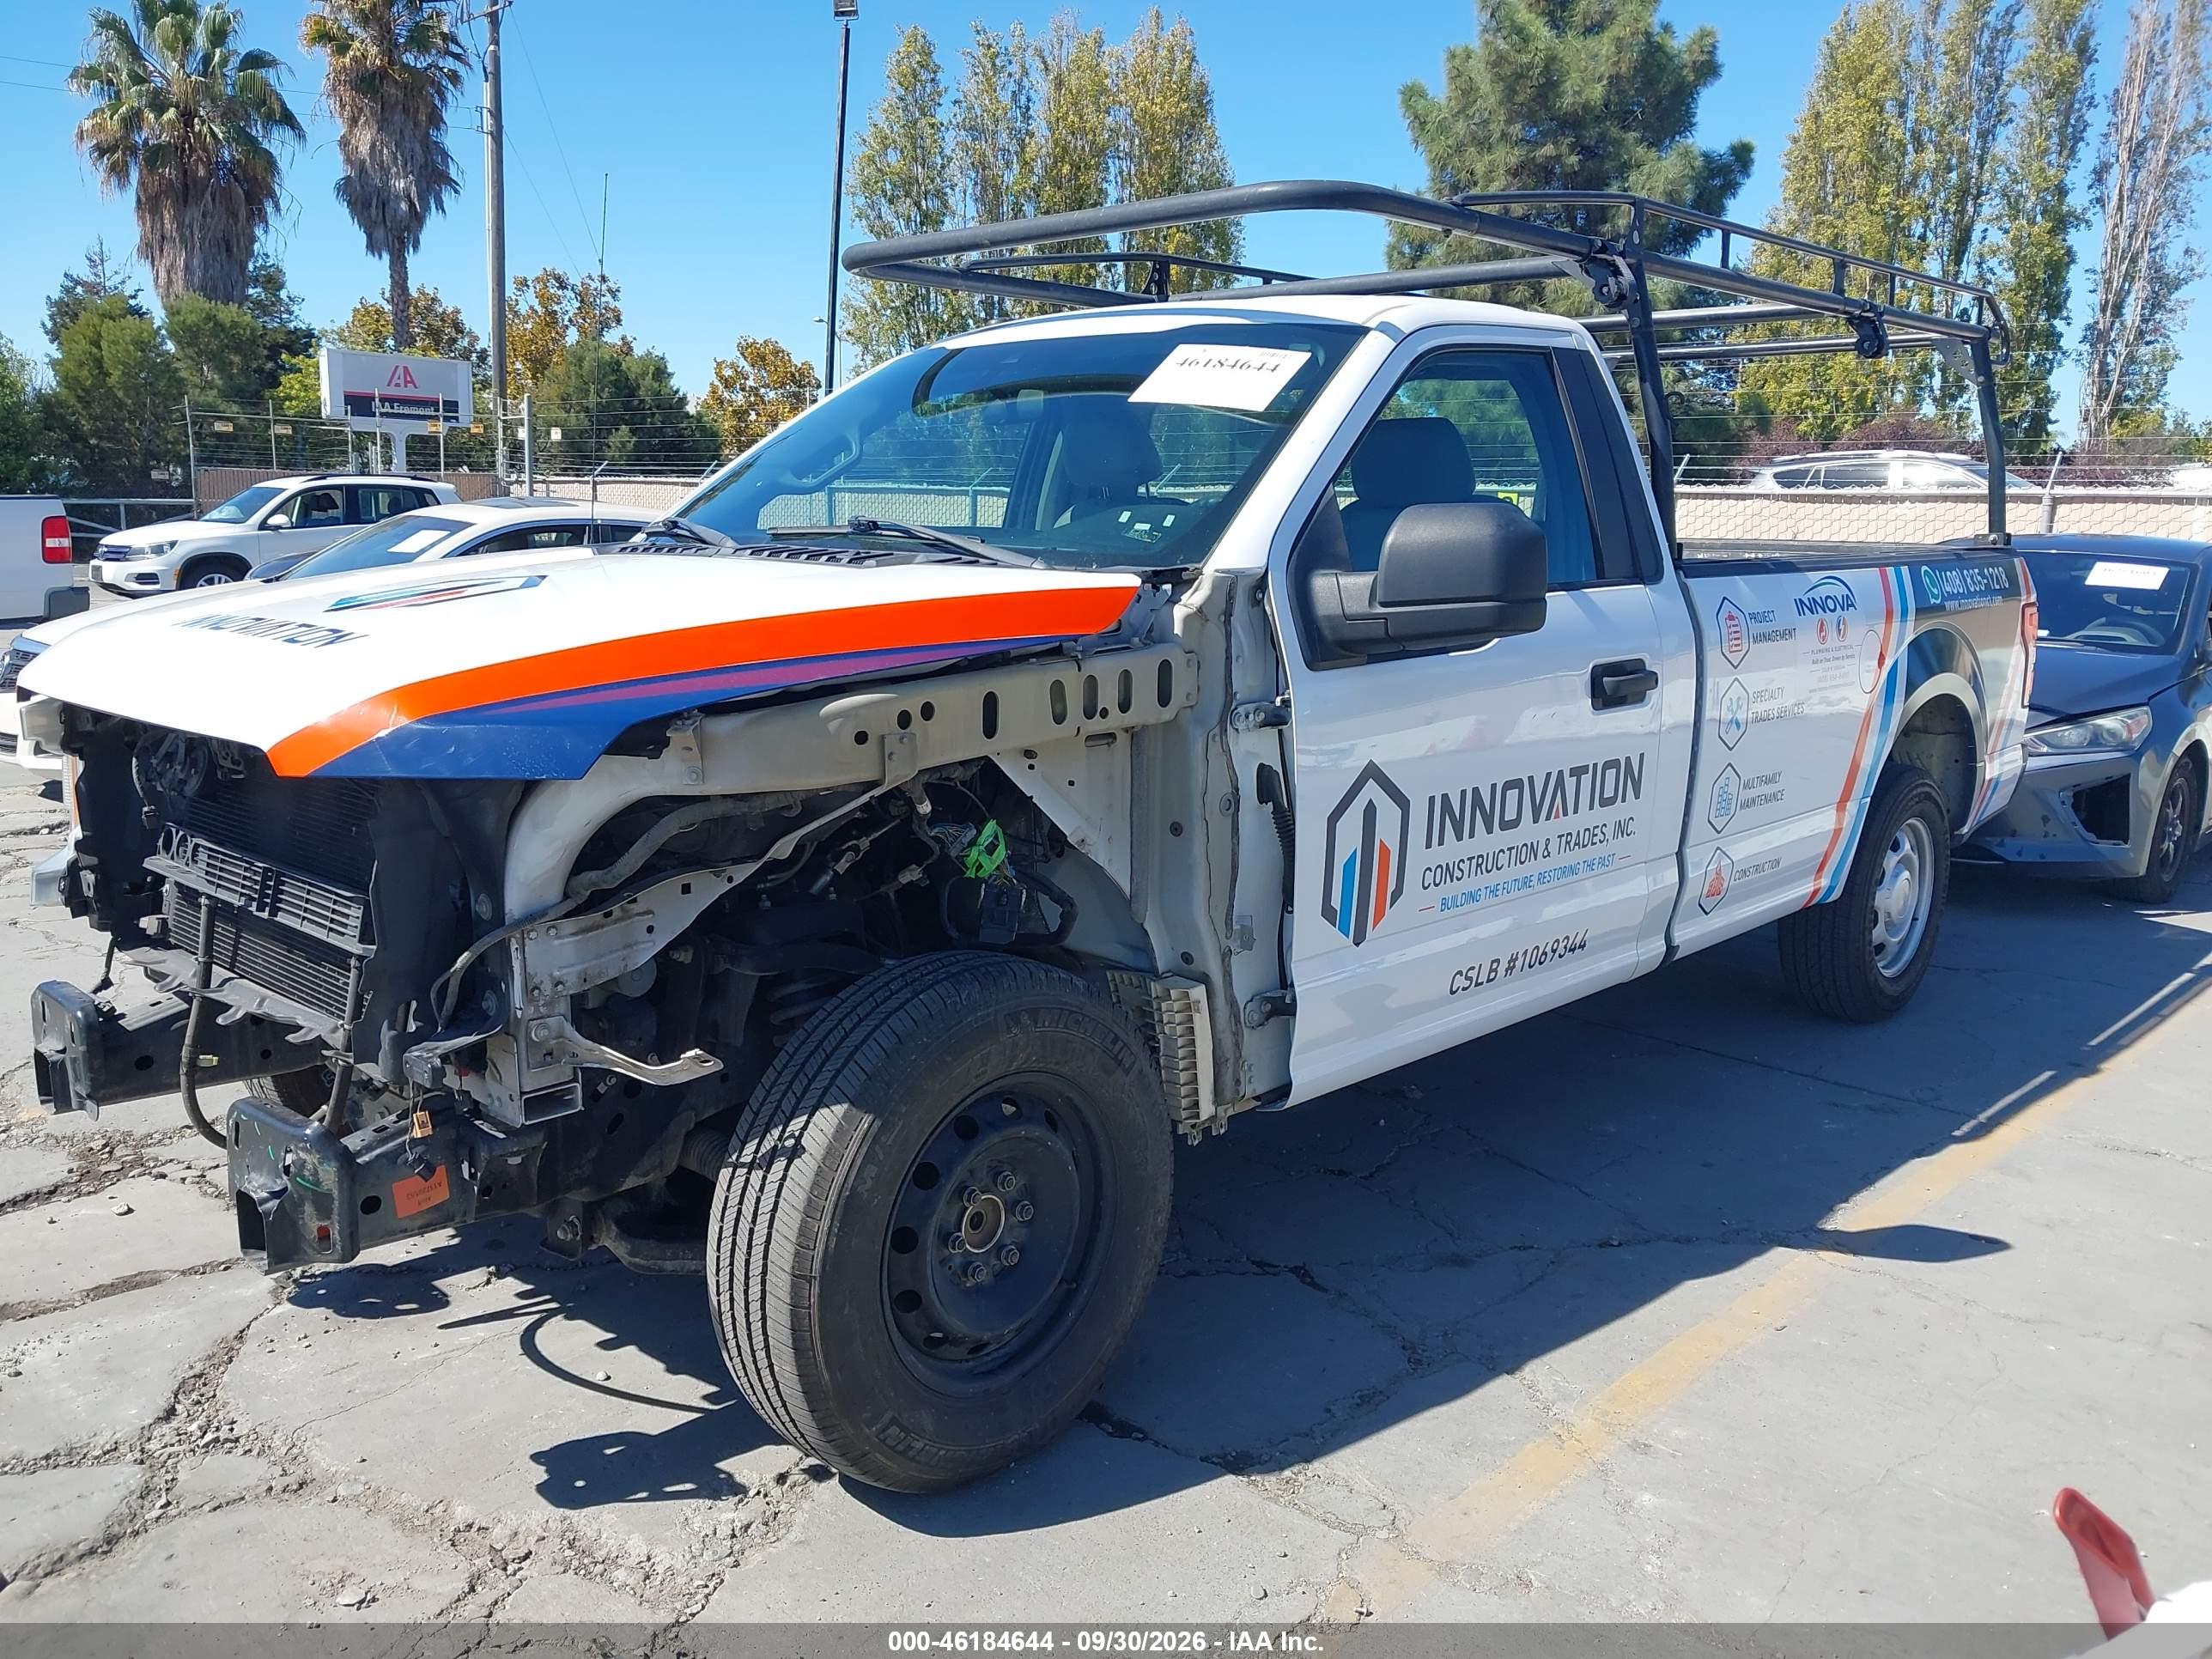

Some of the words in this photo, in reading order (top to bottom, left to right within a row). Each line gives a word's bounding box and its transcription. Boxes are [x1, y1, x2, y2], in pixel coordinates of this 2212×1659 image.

[1936, 568, 1967, 597] (408)
[1963, 567, 2009, 592] 835-1218
[1748, 610, 1776, 624] PROJECT
[1793, 593, 1857, 617] INNOVA
[171, 613, 369, 648] INNOVATION
[1752, 628, 1797, 645] MANAGEMENT
[1752, 686, 1784, 704] SPECIALTY
[1751, 708, 1776, 725] TRADES
[1776, 702, 1805, 720] SERVICES
[1742, 770, 1783, 791] MULTIFAMILY
[1425, 752, 1645, 849] INNOVATION
[1739, 789, 1785, 811] MAINTENANCE
[1421, 838, 1540, 891] CONSTRUCTION
[1542, 838, 1552, 859] &
[1557, 826, 1610, 857] TRADES,
[1612, 816, 1636, 842] INC.
[1734, 857, 1782, 882] CONSTRUCTION
[1439, 883, 1482, 913] BUILDING
[1484, 879, 1500, 900] THE
[1501, 873, 1534, 897] FUTURE,
[1537, 863, 1581, 888] RESTORING
[1582, 858, 1596, 876] THE
[1596, 853, 1616, 872] PAST
[1449, 957, 1502, 996] CSLB
[1504, 927, 1589, 978] #1069344
